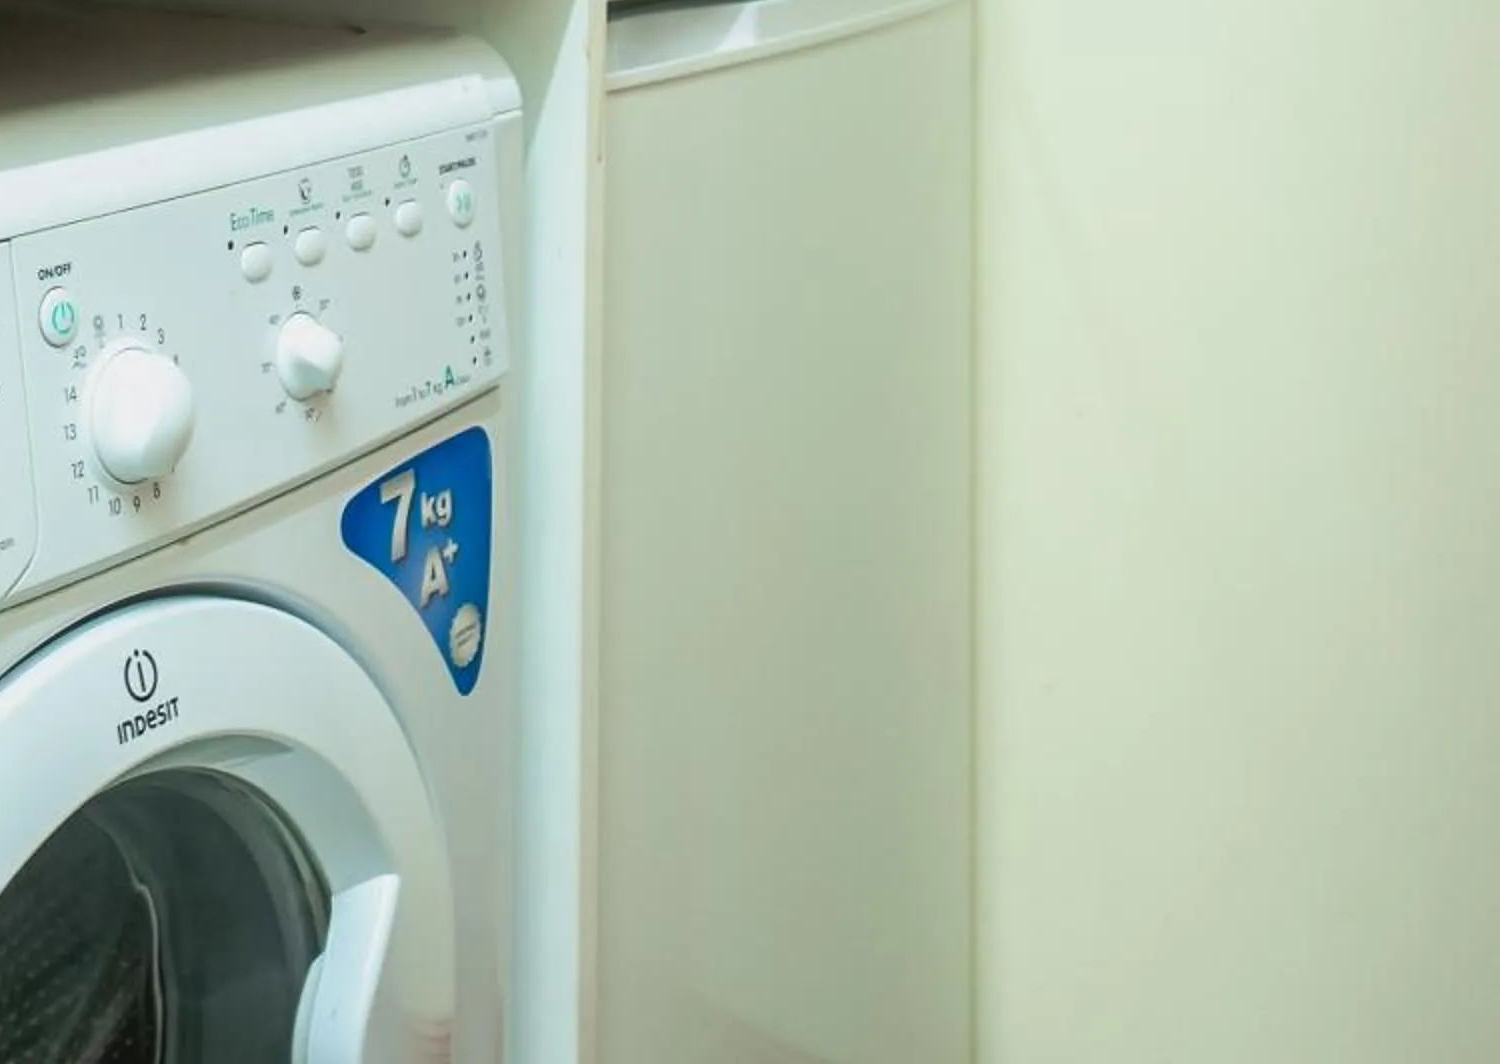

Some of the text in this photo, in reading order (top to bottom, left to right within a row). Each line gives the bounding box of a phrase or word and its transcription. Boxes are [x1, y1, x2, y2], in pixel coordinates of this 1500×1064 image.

[37, 262, 73, 281] ON/OFF
[139, 313, 148, 331] 2
[157, 328, 165, 345] 3
[63, 385, 77, 404] 14
[63, 423, 77, 441] 13
[71, 461, 85, 479] 12
[87, 485, 100, 504] 11
[108, 497, 121, 516] 10
[132, 495, 141, 513] 9
[379, 468, 452, 564] 7 kg
